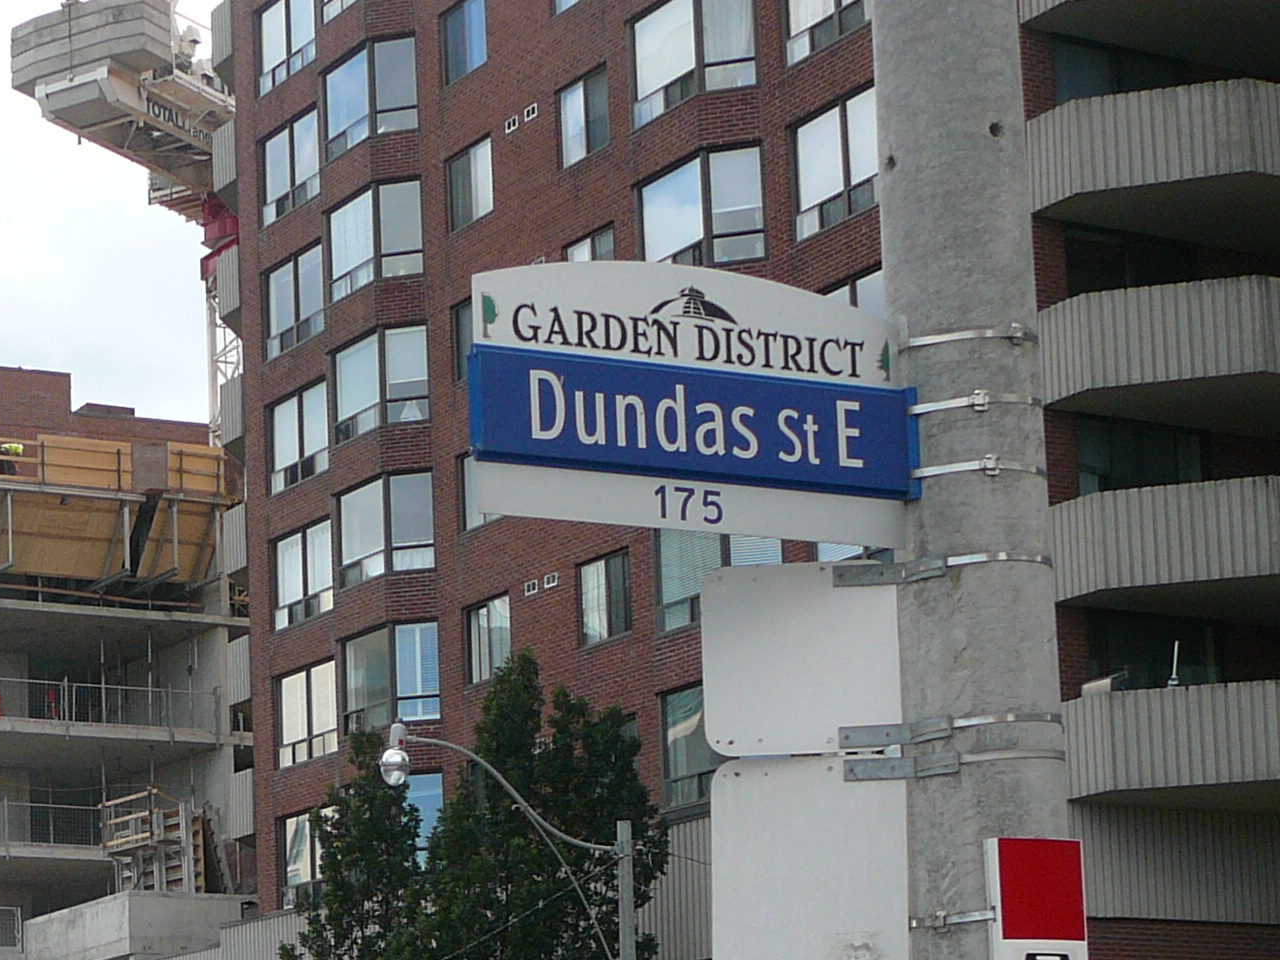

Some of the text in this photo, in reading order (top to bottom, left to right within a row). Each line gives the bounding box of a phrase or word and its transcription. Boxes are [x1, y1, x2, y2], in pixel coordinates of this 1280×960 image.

[511, 303, 865, 378] GARDEN DISTRICT
[528, 369, 865, 469] Dundas St E
[653, 485, 724, 525] 175
